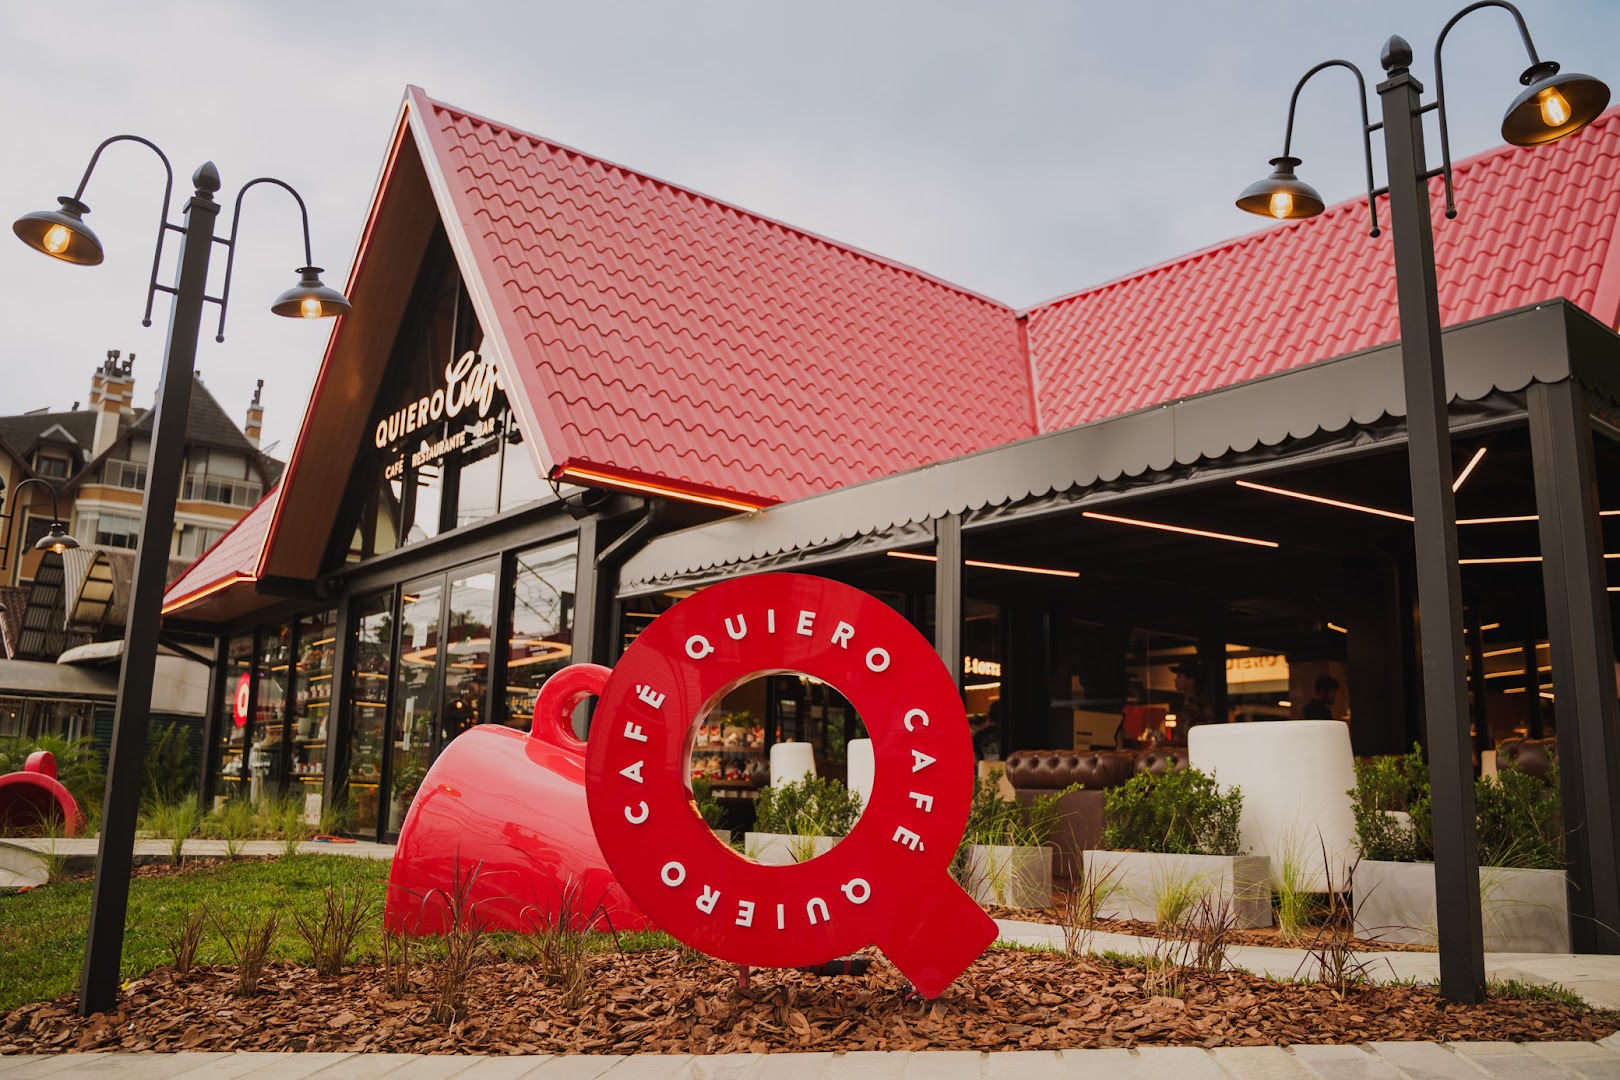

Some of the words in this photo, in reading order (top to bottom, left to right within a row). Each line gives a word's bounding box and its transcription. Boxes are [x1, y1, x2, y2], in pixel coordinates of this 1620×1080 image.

[375, 388, 445, 448] QUIERO
[445, 350, 505, 418] Caf
[385, 453, 404, 480] CAFÉ
[411, 431, 467, 468] RESTAURANTE
[477, 417, 496, 438] BAR
[685, 608, 891, 672] QUIERO
[1226, 653, 1278, 671] UIERO
[619, 684, 666, 825] CAFÉ
[892, 708, 936, 852] CAFÉ
[661, 861, 871, 930] QUIERO
